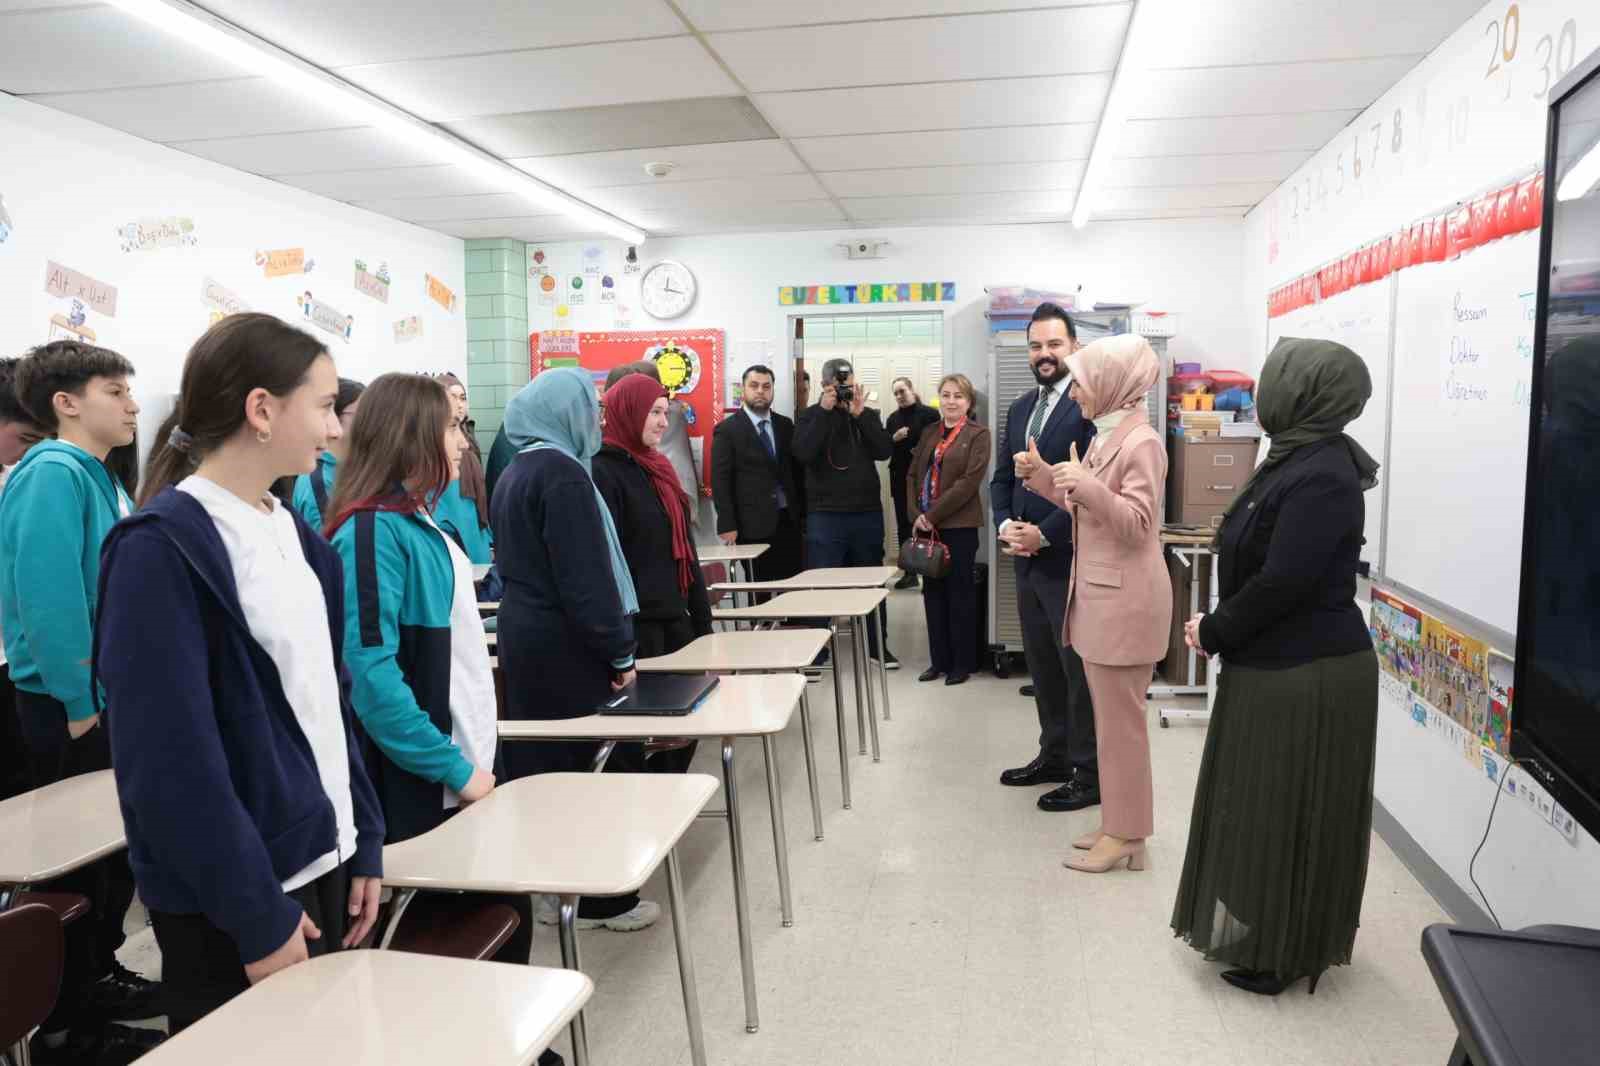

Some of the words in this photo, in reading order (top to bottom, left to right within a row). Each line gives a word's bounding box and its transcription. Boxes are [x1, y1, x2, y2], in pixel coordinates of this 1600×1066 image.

[1391, 107, 1403, 153] 8
[1484, 3, 1520, 80] 20
[1533, 18, 1577, 100] 30
